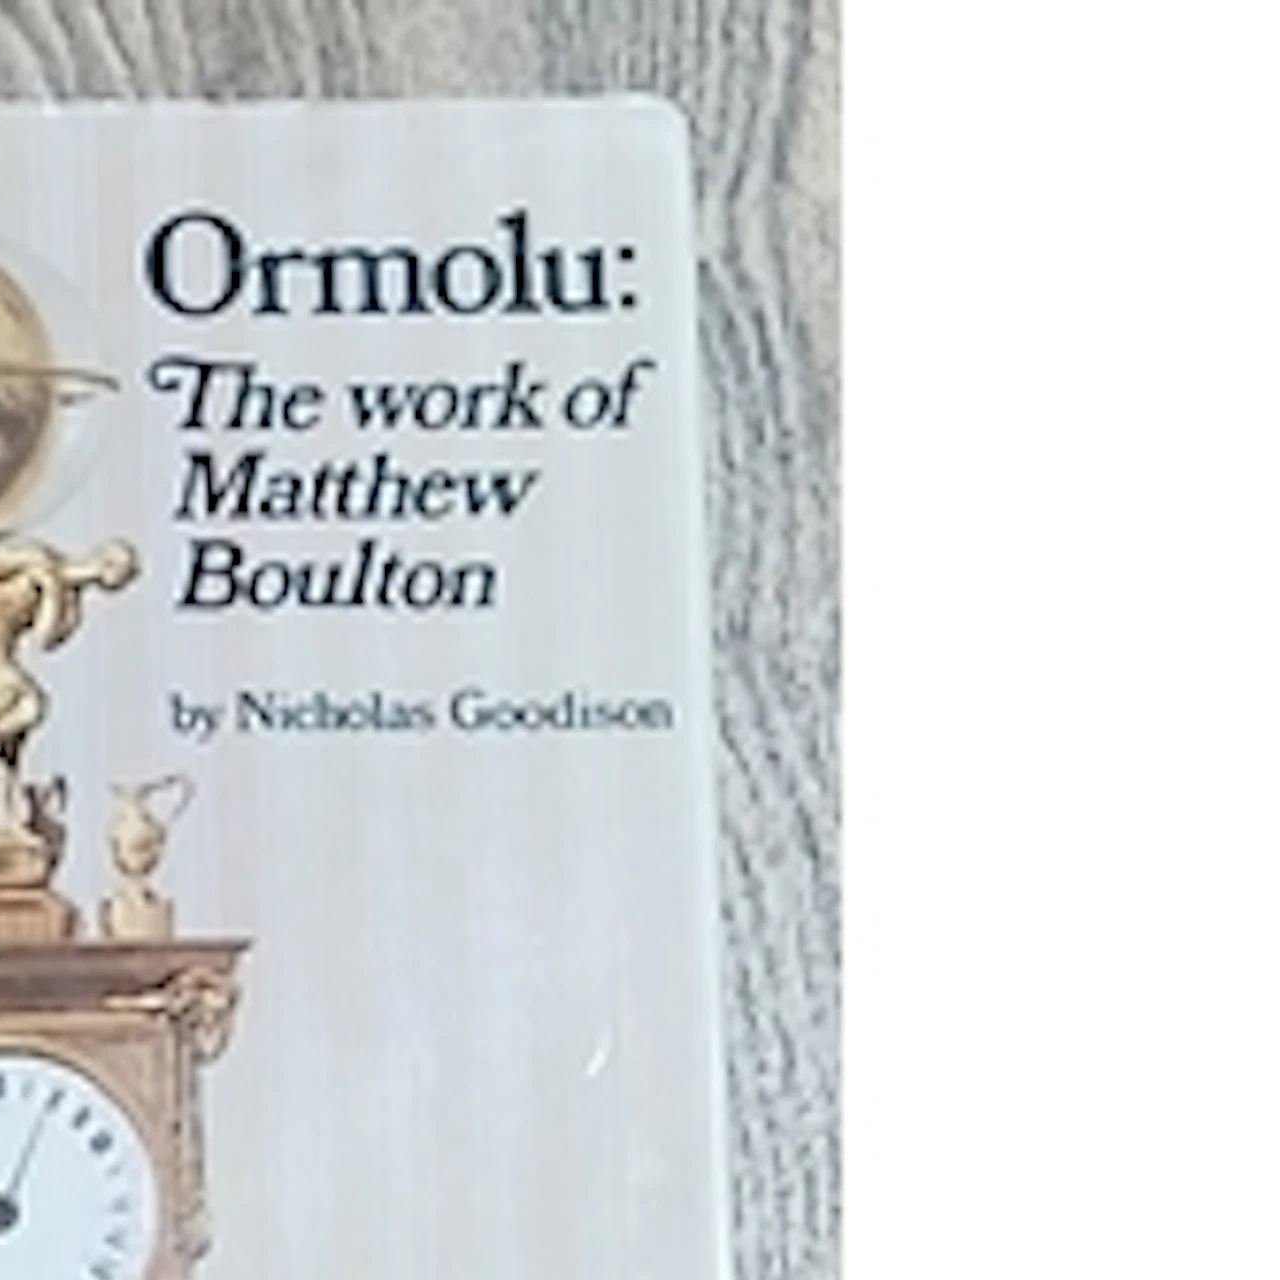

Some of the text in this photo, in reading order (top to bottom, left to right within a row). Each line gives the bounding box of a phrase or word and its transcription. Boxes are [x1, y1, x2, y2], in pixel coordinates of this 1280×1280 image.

[146, 209, 637, 316] Ormolu:
[148, 354, 656, 431] The work of
[173, 452, 542, 520] Matthew
[174, 537, 498, 610] Boulton
[171, 689, 675, 741] by Nicholas Goodison
